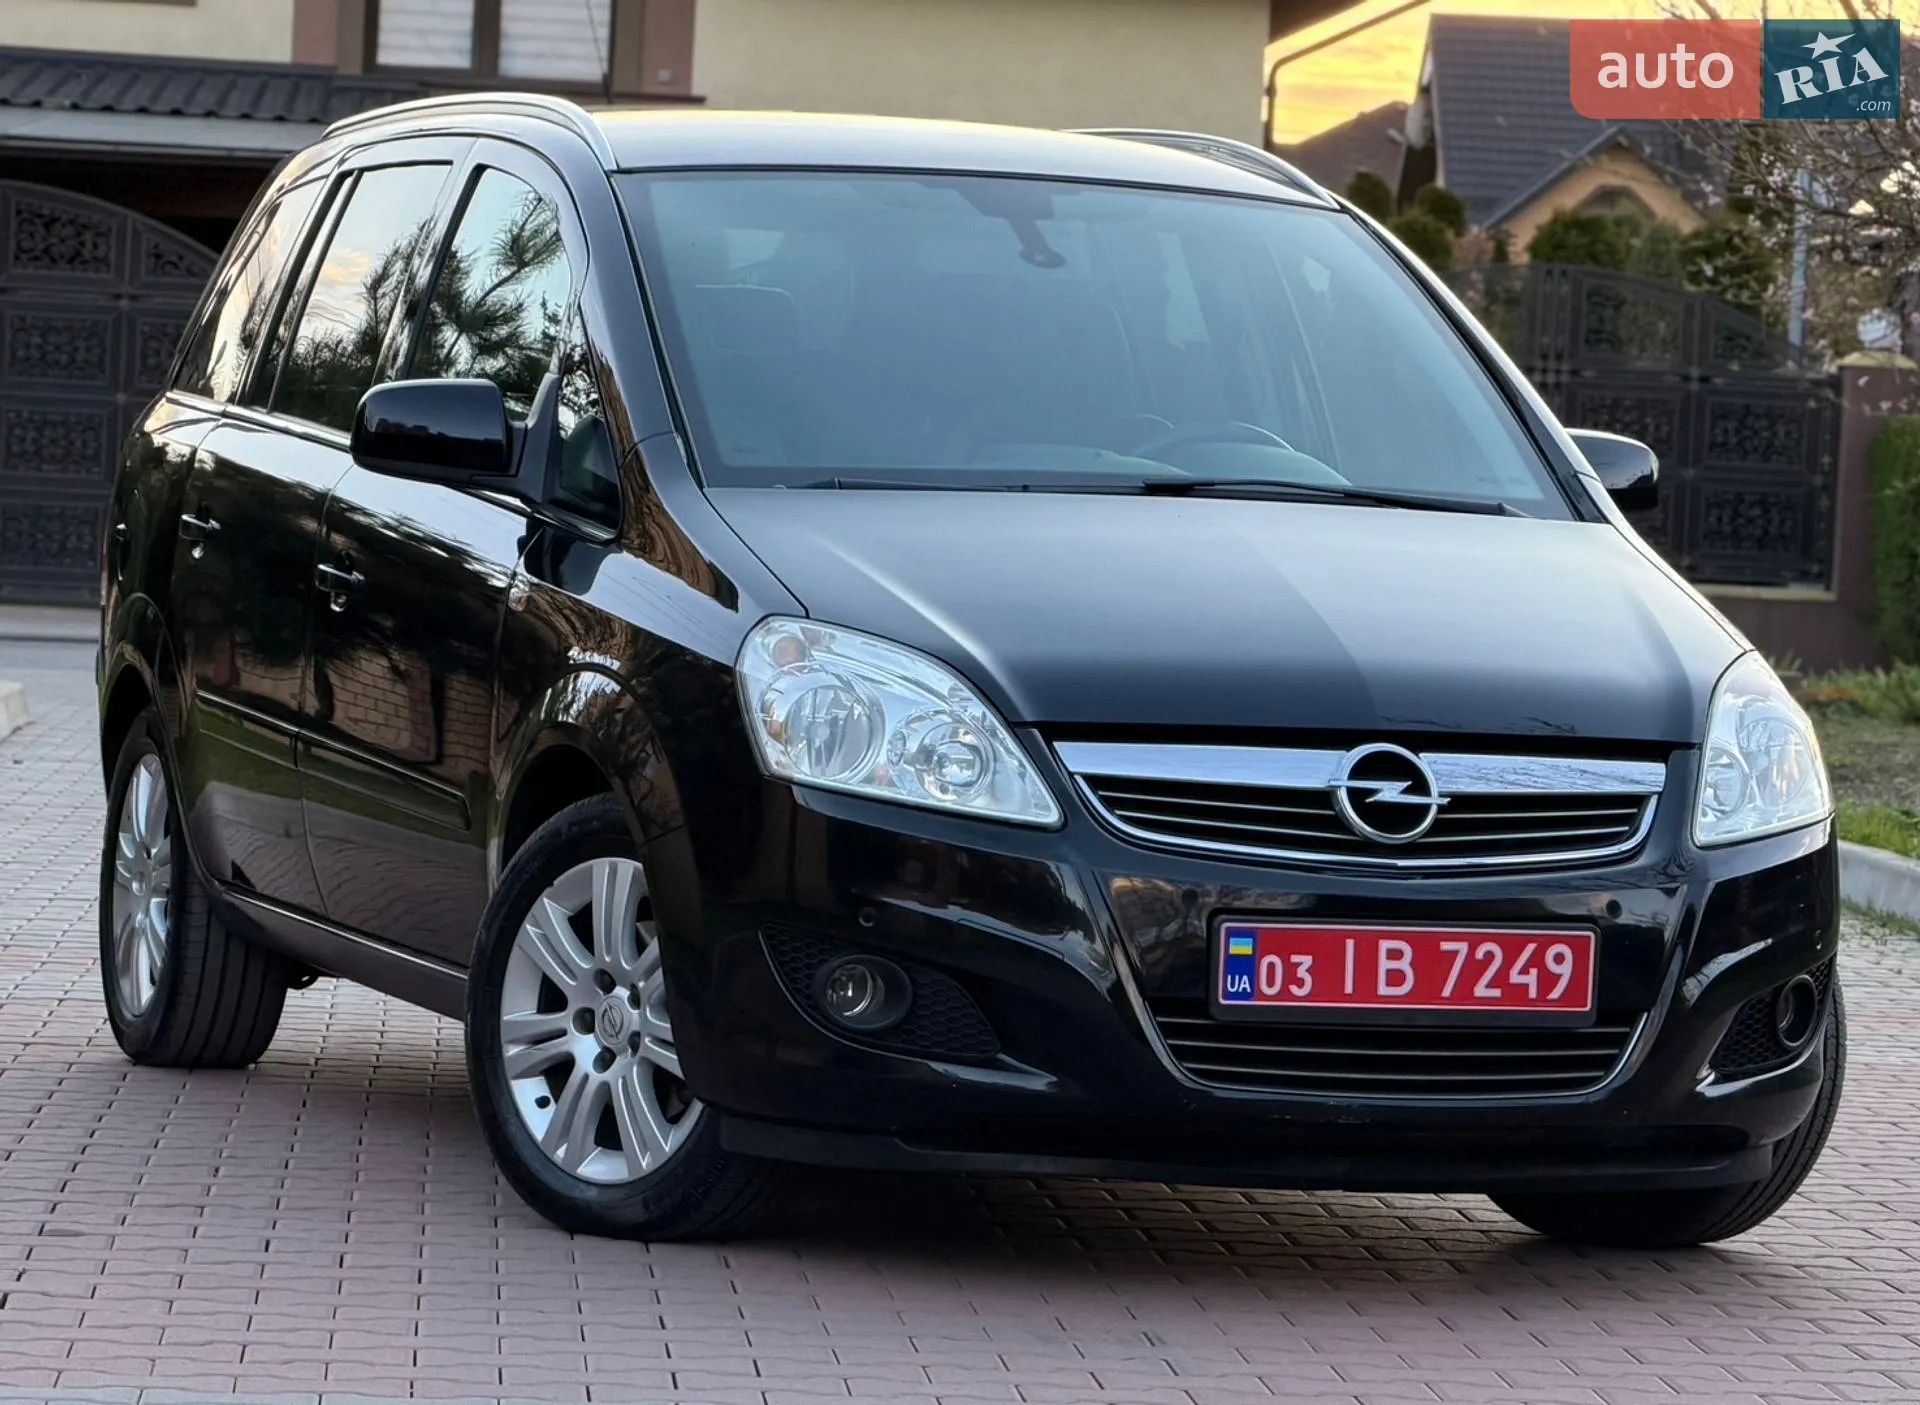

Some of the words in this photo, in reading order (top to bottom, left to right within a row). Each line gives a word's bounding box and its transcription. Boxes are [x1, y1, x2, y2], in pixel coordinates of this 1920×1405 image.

[1226, 974, 1252, 994] UA
[1258, 953, 1314, 998] 03
[1439, 941, 1574, 1001] 7249
